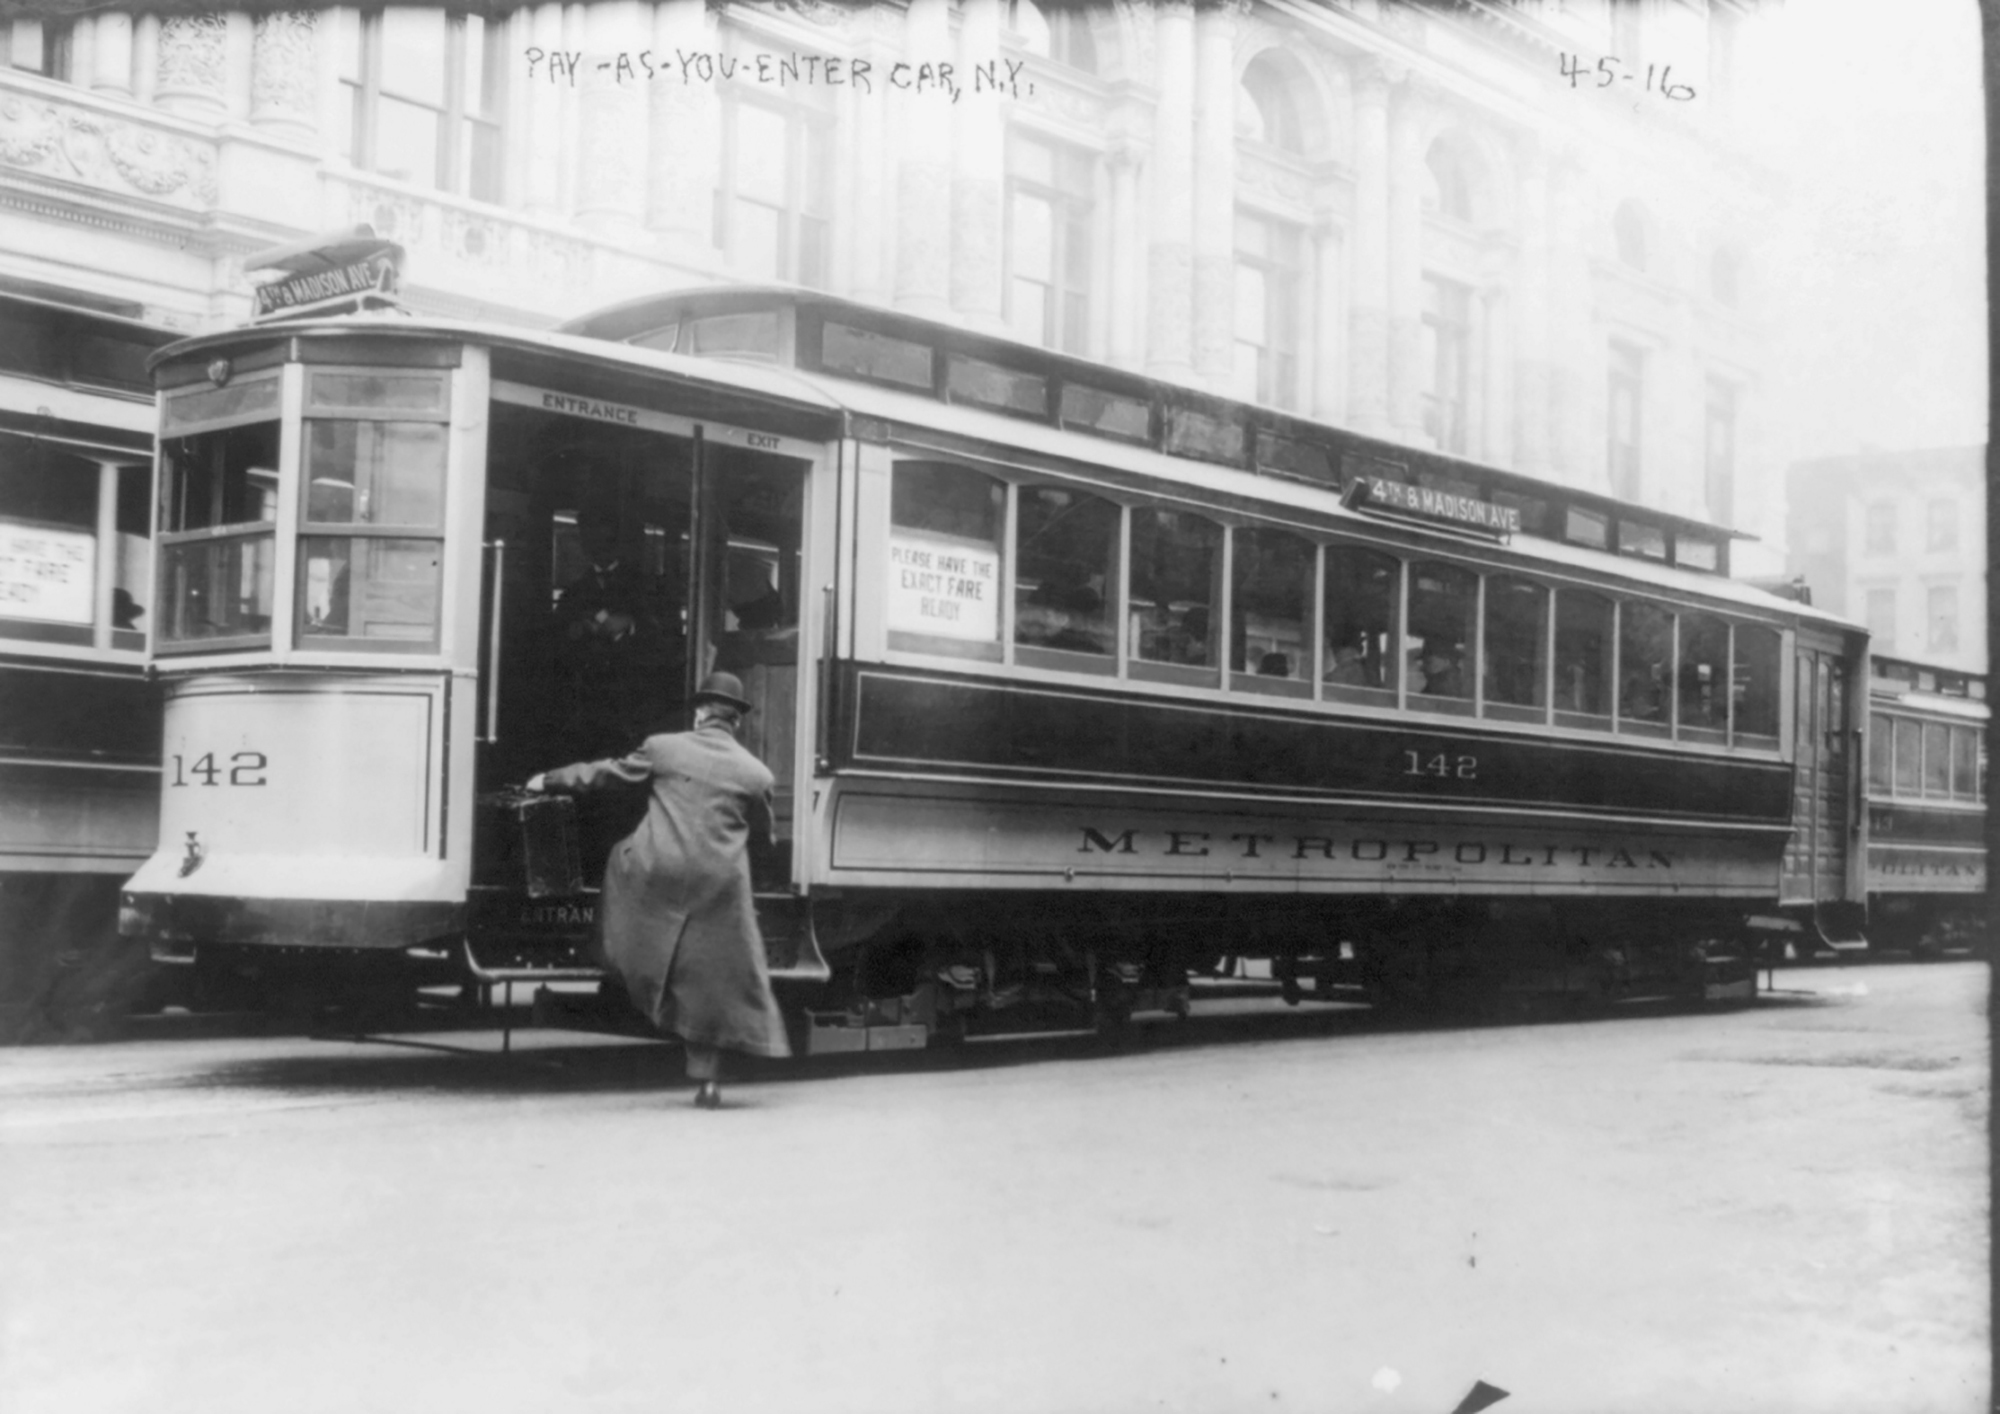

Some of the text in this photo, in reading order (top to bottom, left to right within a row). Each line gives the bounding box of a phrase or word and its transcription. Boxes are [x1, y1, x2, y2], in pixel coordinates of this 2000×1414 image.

[289, 269, 349, 305] MADISON
[542, 393, 638, 424] ENTRANCE
[747, 432, 781, 449] EXIT
[1407, 486, 1419, 509] &
[1422, 488, 1486, 523] MADISON
[891, 546, 992, 579] PLEASE HAVE THE
[901, 568, 983, 601] EXACT FARE
[921, 596, 961, 621] READY
[171, 752, 267, 787] 142
[1404, 749, 1477, 779] 142
[1077, 827, 1674, 869] METROPOLITAN
